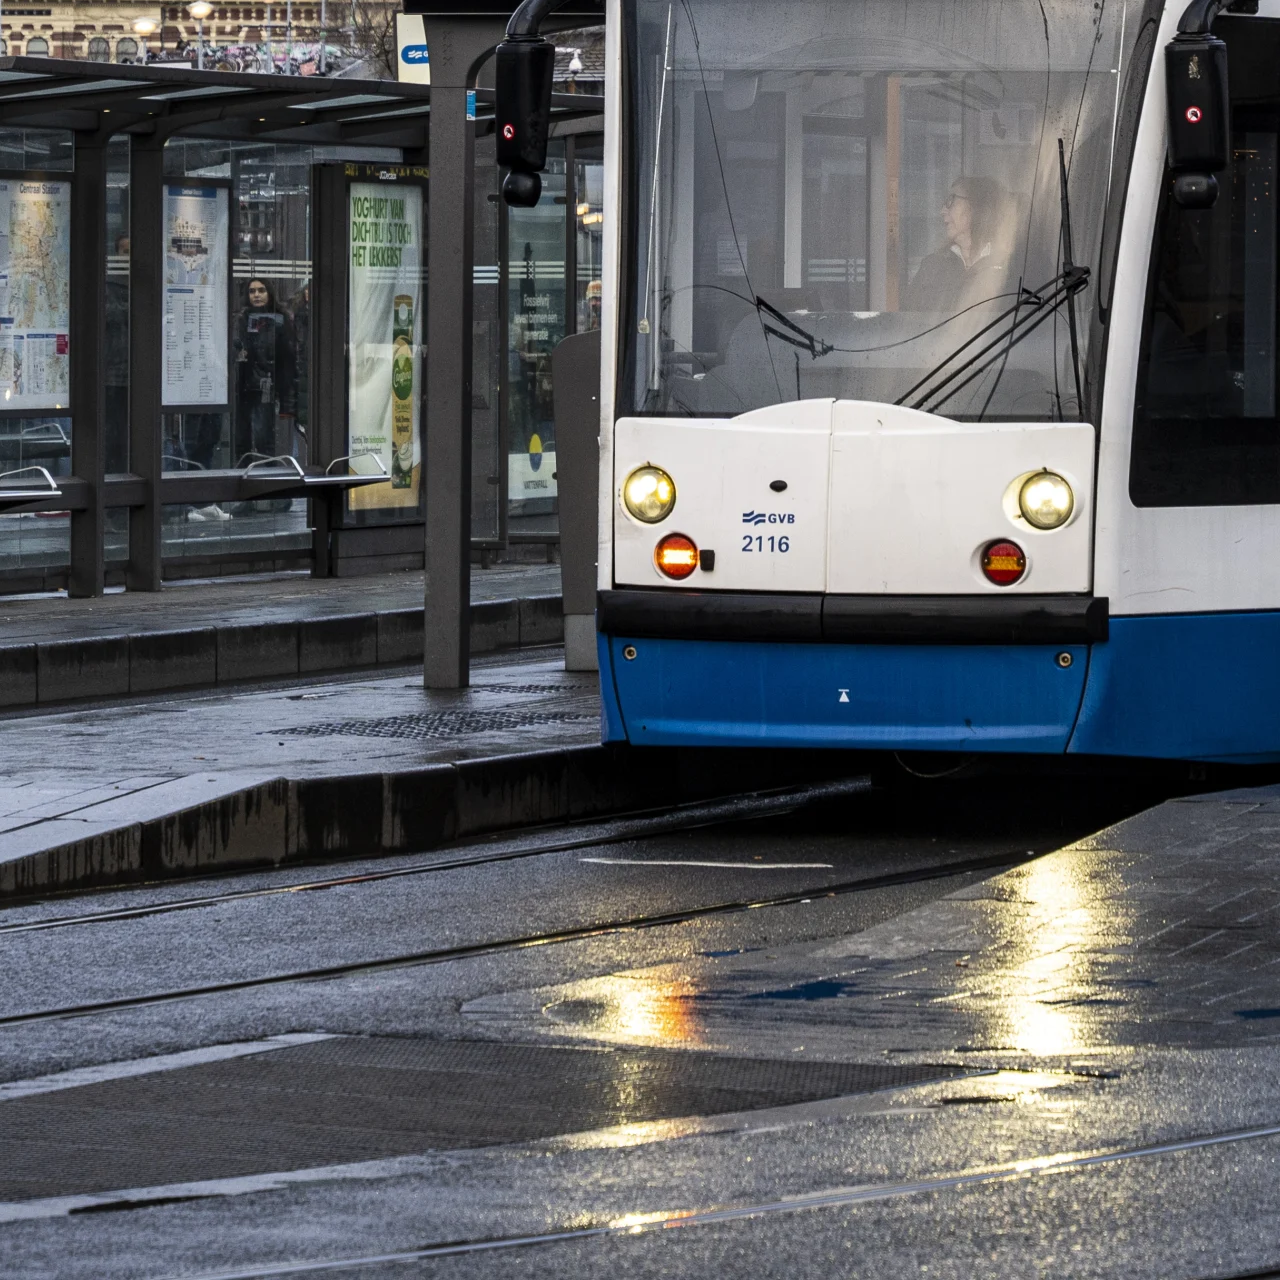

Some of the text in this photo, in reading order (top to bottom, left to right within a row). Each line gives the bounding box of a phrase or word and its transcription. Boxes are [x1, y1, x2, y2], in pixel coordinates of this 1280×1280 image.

[352, 197, 404, 220] YOGHURT VAN
[352, 221, 412, 244] DICHTBIJ IS TOCH
[352, 246, 402, 267] HET LEKKERST
[768, 513, 795, 524] GVB
[742, 535, 790, 553] 2116
